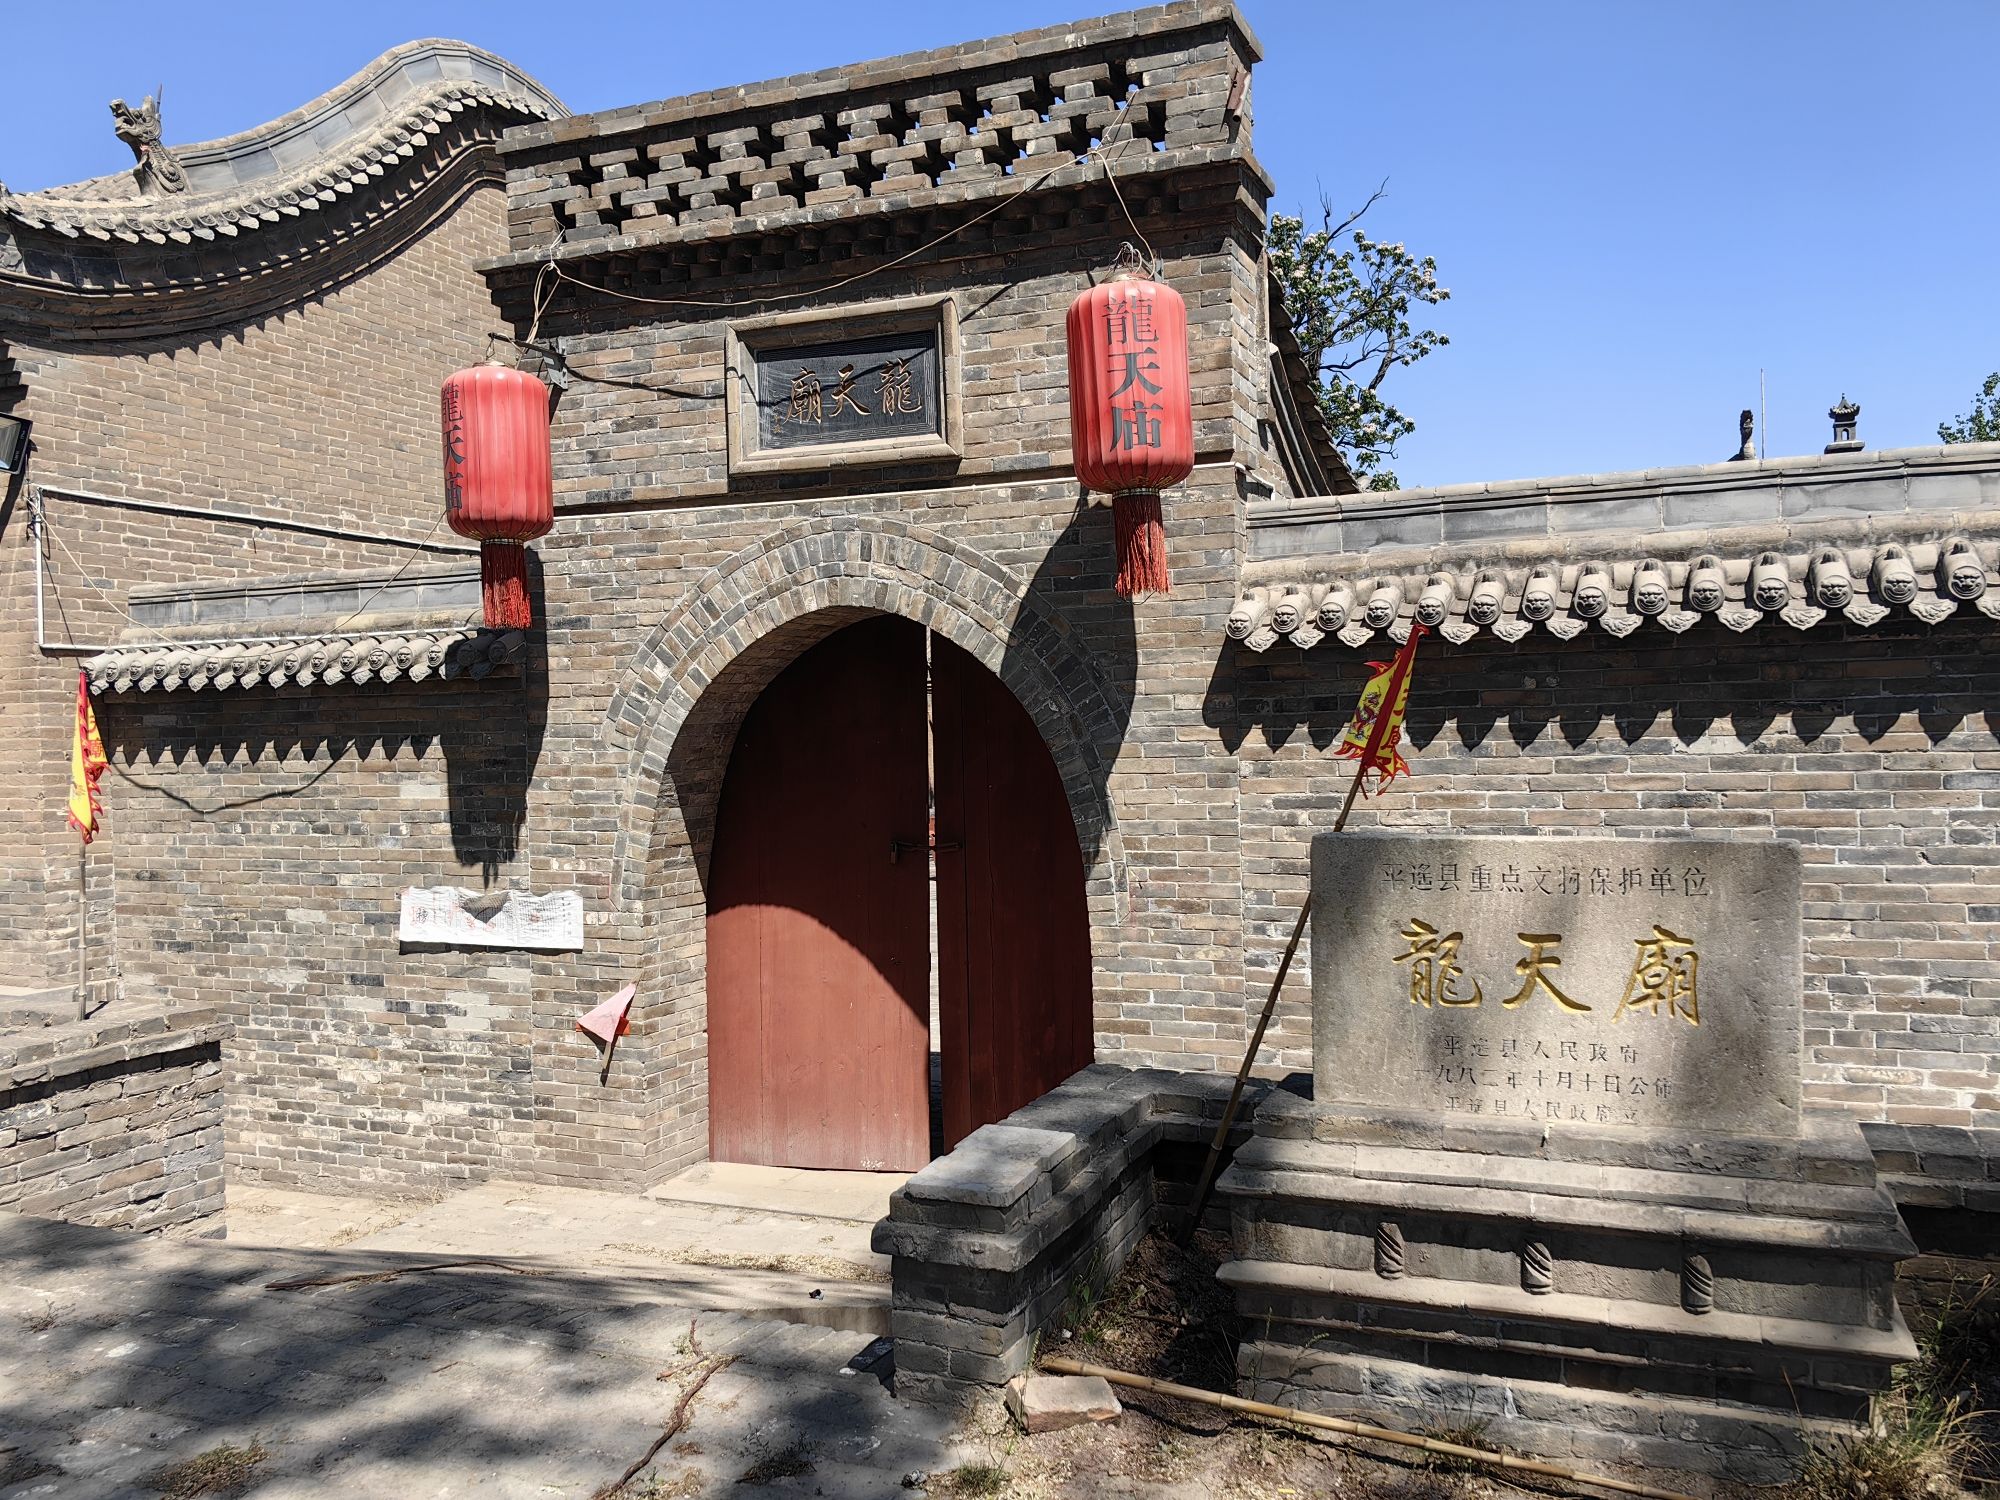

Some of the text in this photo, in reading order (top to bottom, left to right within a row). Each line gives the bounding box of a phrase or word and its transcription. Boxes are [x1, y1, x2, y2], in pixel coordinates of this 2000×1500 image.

[1102, 296, 1163, 453] 龍天庙
[1392, 917, 1701, 1027] 龍天廟
